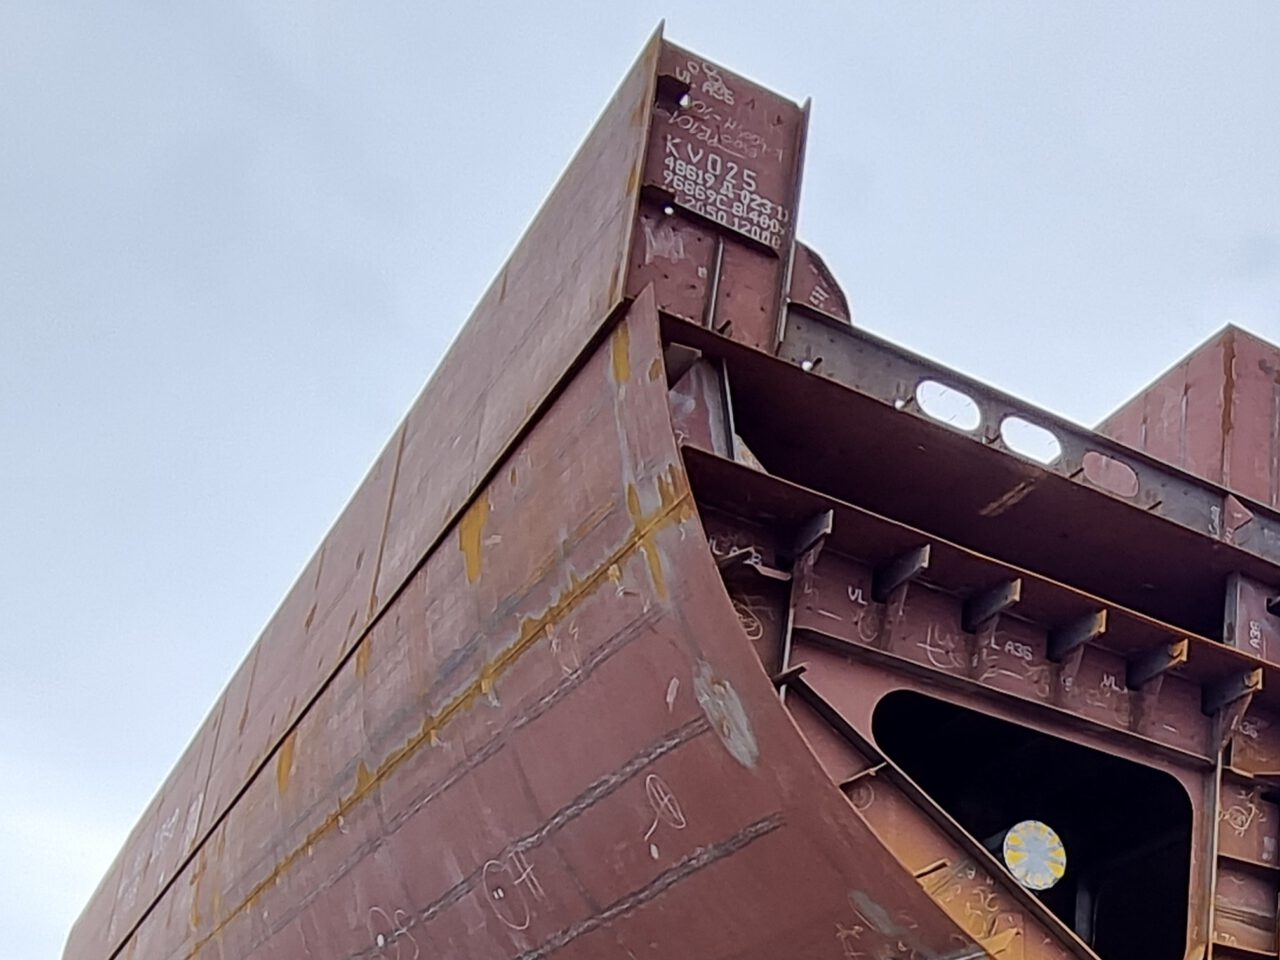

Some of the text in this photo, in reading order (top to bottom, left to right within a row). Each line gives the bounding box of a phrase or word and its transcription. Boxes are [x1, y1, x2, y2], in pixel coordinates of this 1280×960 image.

[665, 157, 716, 187] 48619
[1249, 620, 1262, 649] A36
[1004, 640, 1033, 661] A36
